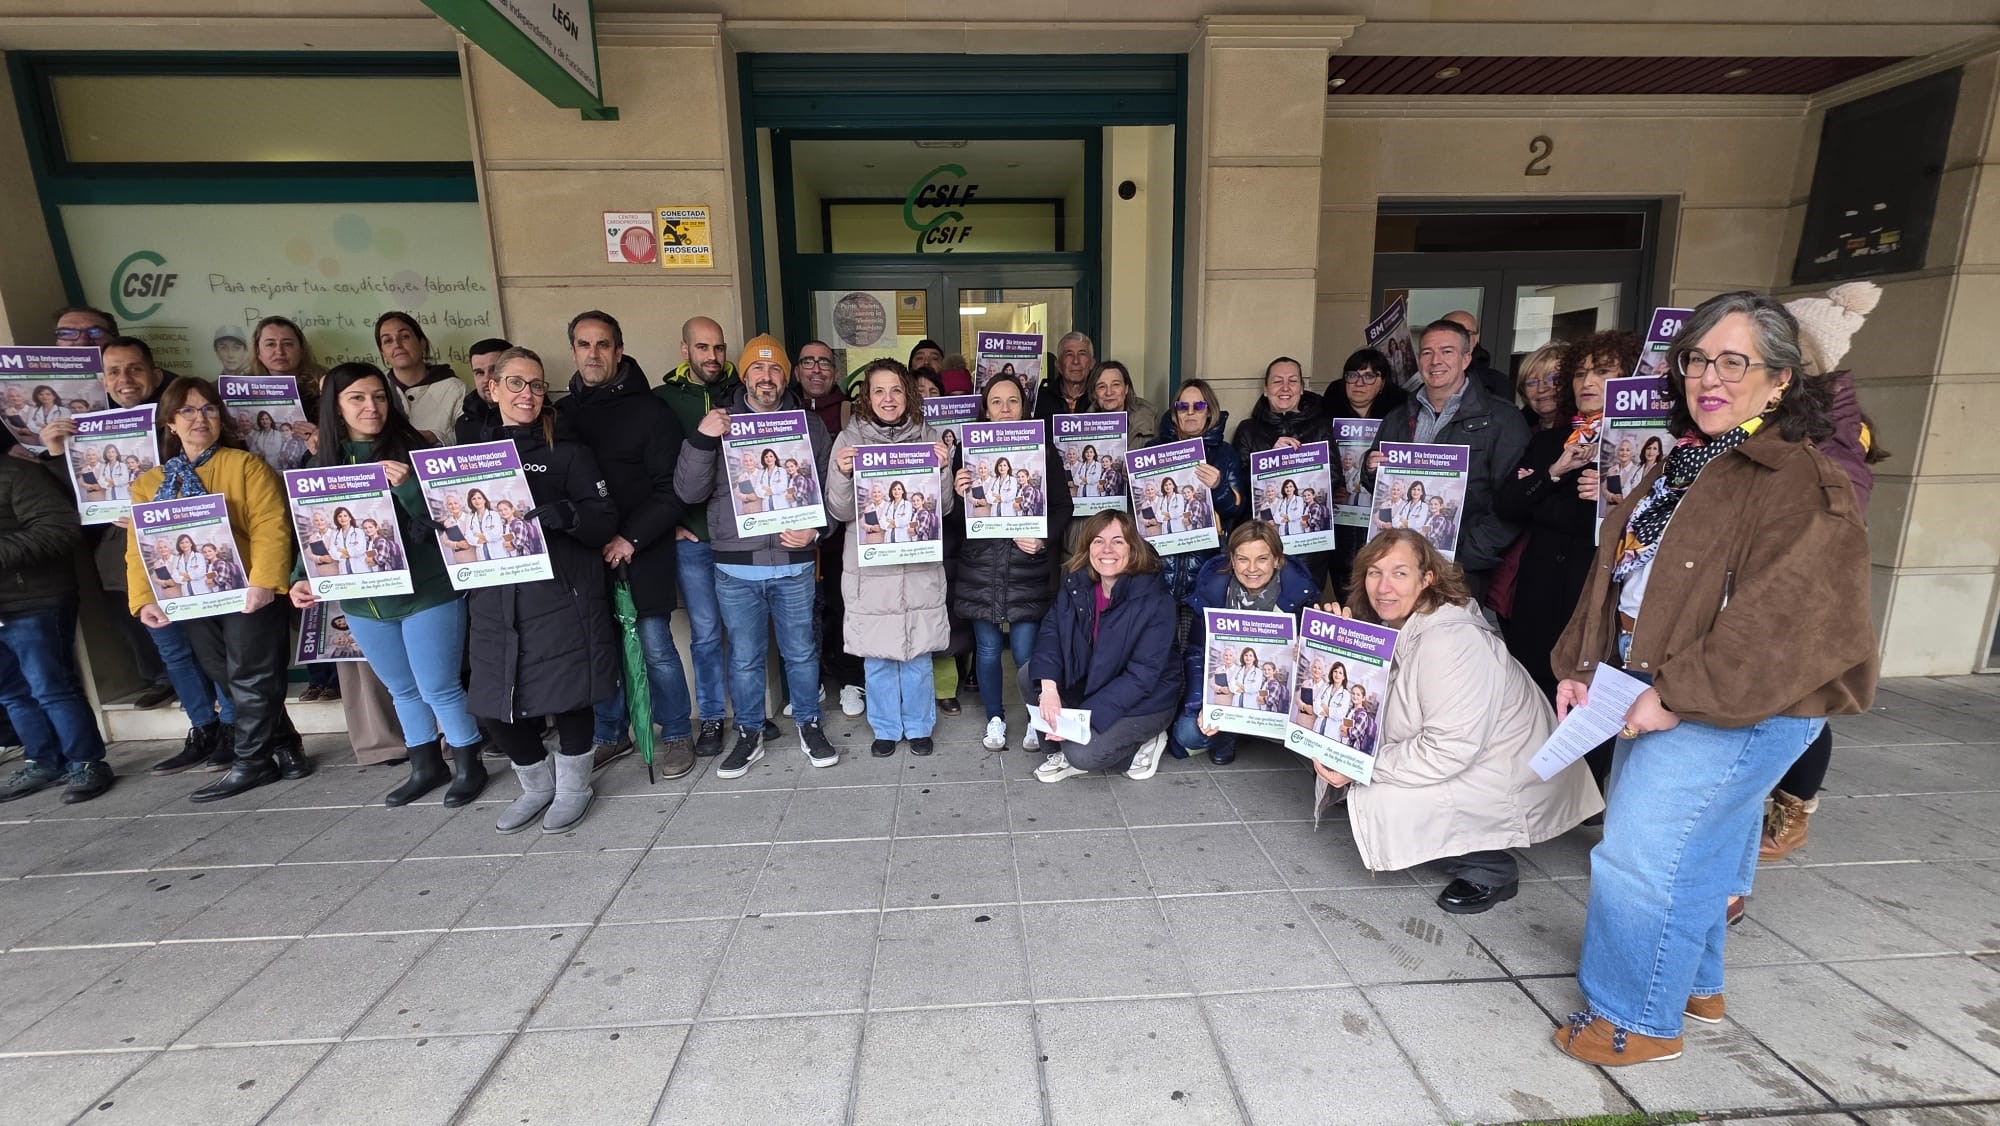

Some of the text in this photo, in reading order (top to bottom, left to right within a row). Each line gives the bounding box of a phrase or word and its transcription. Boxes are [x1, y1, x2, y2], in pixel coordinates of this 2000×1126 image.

[552, 3, 578, 40] LEÓN
[1525, 136, 1553, 176] 2
[123, 273, 178, 297] CSIF
[209, 274, 486, 300] Para mejorar tus condiciones laborales
[291, 310, 332, 332] ejorar
[336, 312, 355, 329] tu
[444, 310, 490, 328] laboral
[1370, 322, 1384, 339] 8M
[985, 338, 1004, 350] 8M
[0, 354, 24, 369] M
[226, 383, 250, 396] 8M
[1616, 389, 1647, 410] 8M
[1651, 400, 1659, 409] de
[79, 420, 104, 432] 8M
[731, 422, 756, 436] 8M
[766, 419, 798, 427] Internacional
[1061, 421, 1081, 432] 8M
[971, 430, 994, 443] 8M
[1340, 425, 1362, 437] 8M
[468, 451, 507, 462] Internacional
[1166, 446, 1196, 457] Internacional
[1289, 450, 1320, 459] Internacional
[1388, 450, 1411, 464] 8M
[1423, 452, 1458, 460] Internacional
[425, 456, 457, 474] 8M
[469, 462, 478, 470] las
[479, 459, 502, 468] Mujeres
[863, 452, 887, 466] 8M
[1134, 454, 1156, 468] 8M
[1259, 456, 1280, 470] 8M
[338, 473, 375, 482] Internacional
[296, 477, 326, 492] 8M
[181, 503, 216, 512] Internacional
[189, 510, 210, 518] Mujeres
[143, 508, 170, 523] 8M
[1216, 618, 1240, 631] 8M
[1251, 620, 1284, 629] Internacional
[1309, 620, 1336, 640] 8M
[304, 631, 316, 653] 8M
[1348, 628, 1386, 645] Internacional
[1353, 638, 1376, 651] Mujeres
